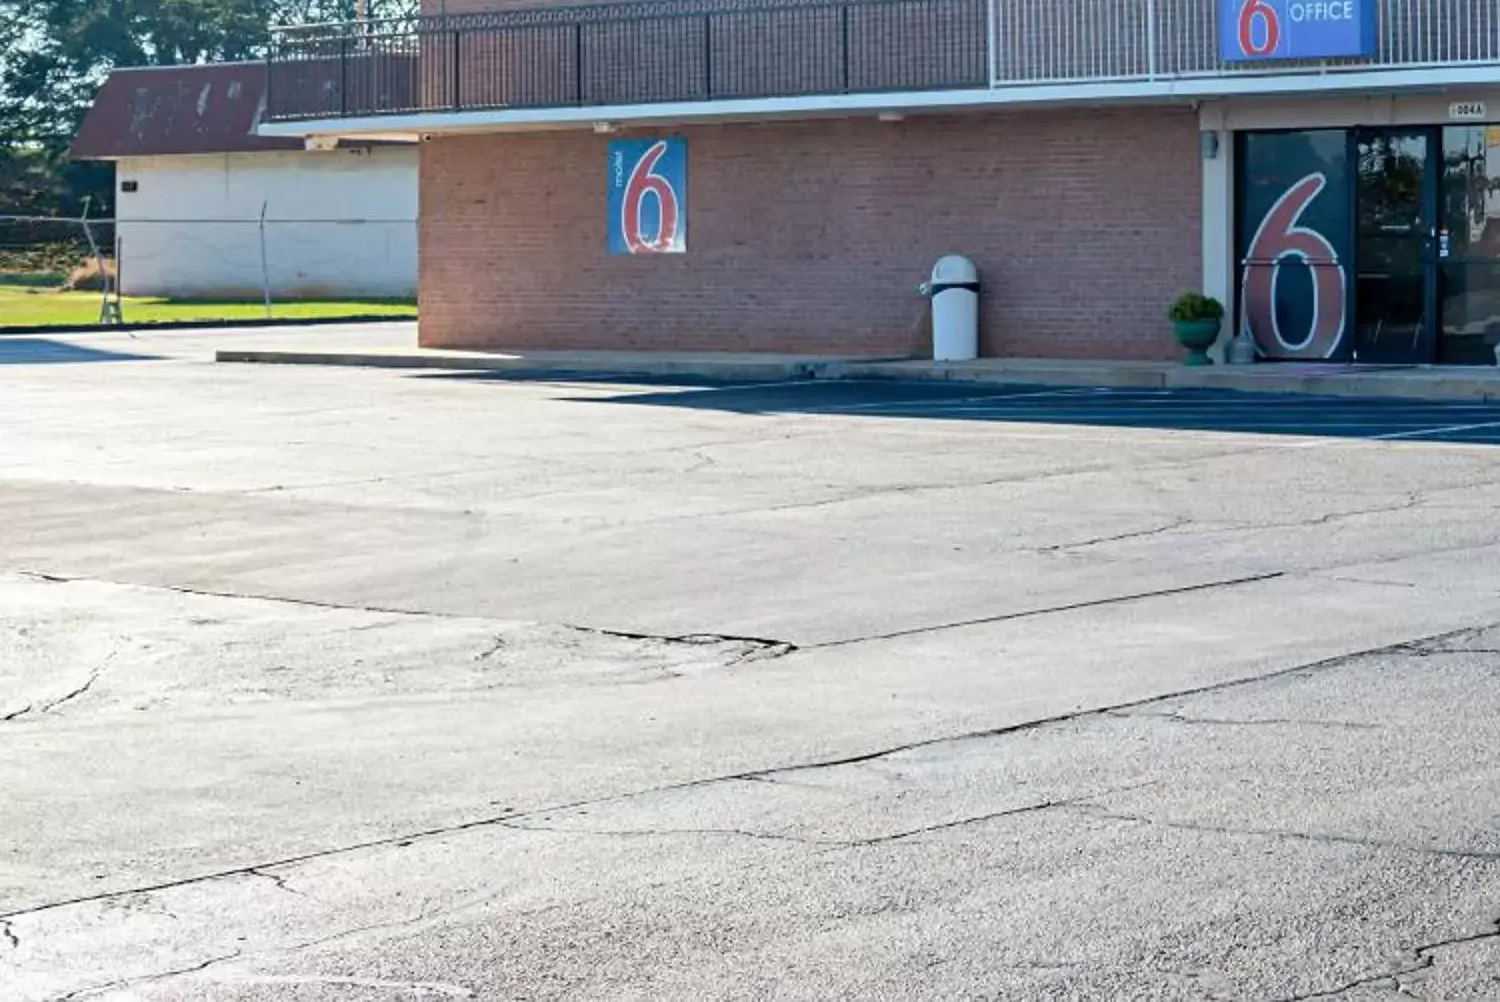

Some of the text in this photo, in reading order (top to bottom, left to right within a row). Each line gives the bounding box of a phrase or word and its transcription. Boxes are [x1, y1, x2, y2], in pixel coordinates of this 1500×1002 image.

[1290, 0, 1353, 22] OFFICE
[622, 141, 677, 254] 6
[1241, 172, 1346, 358] 6
